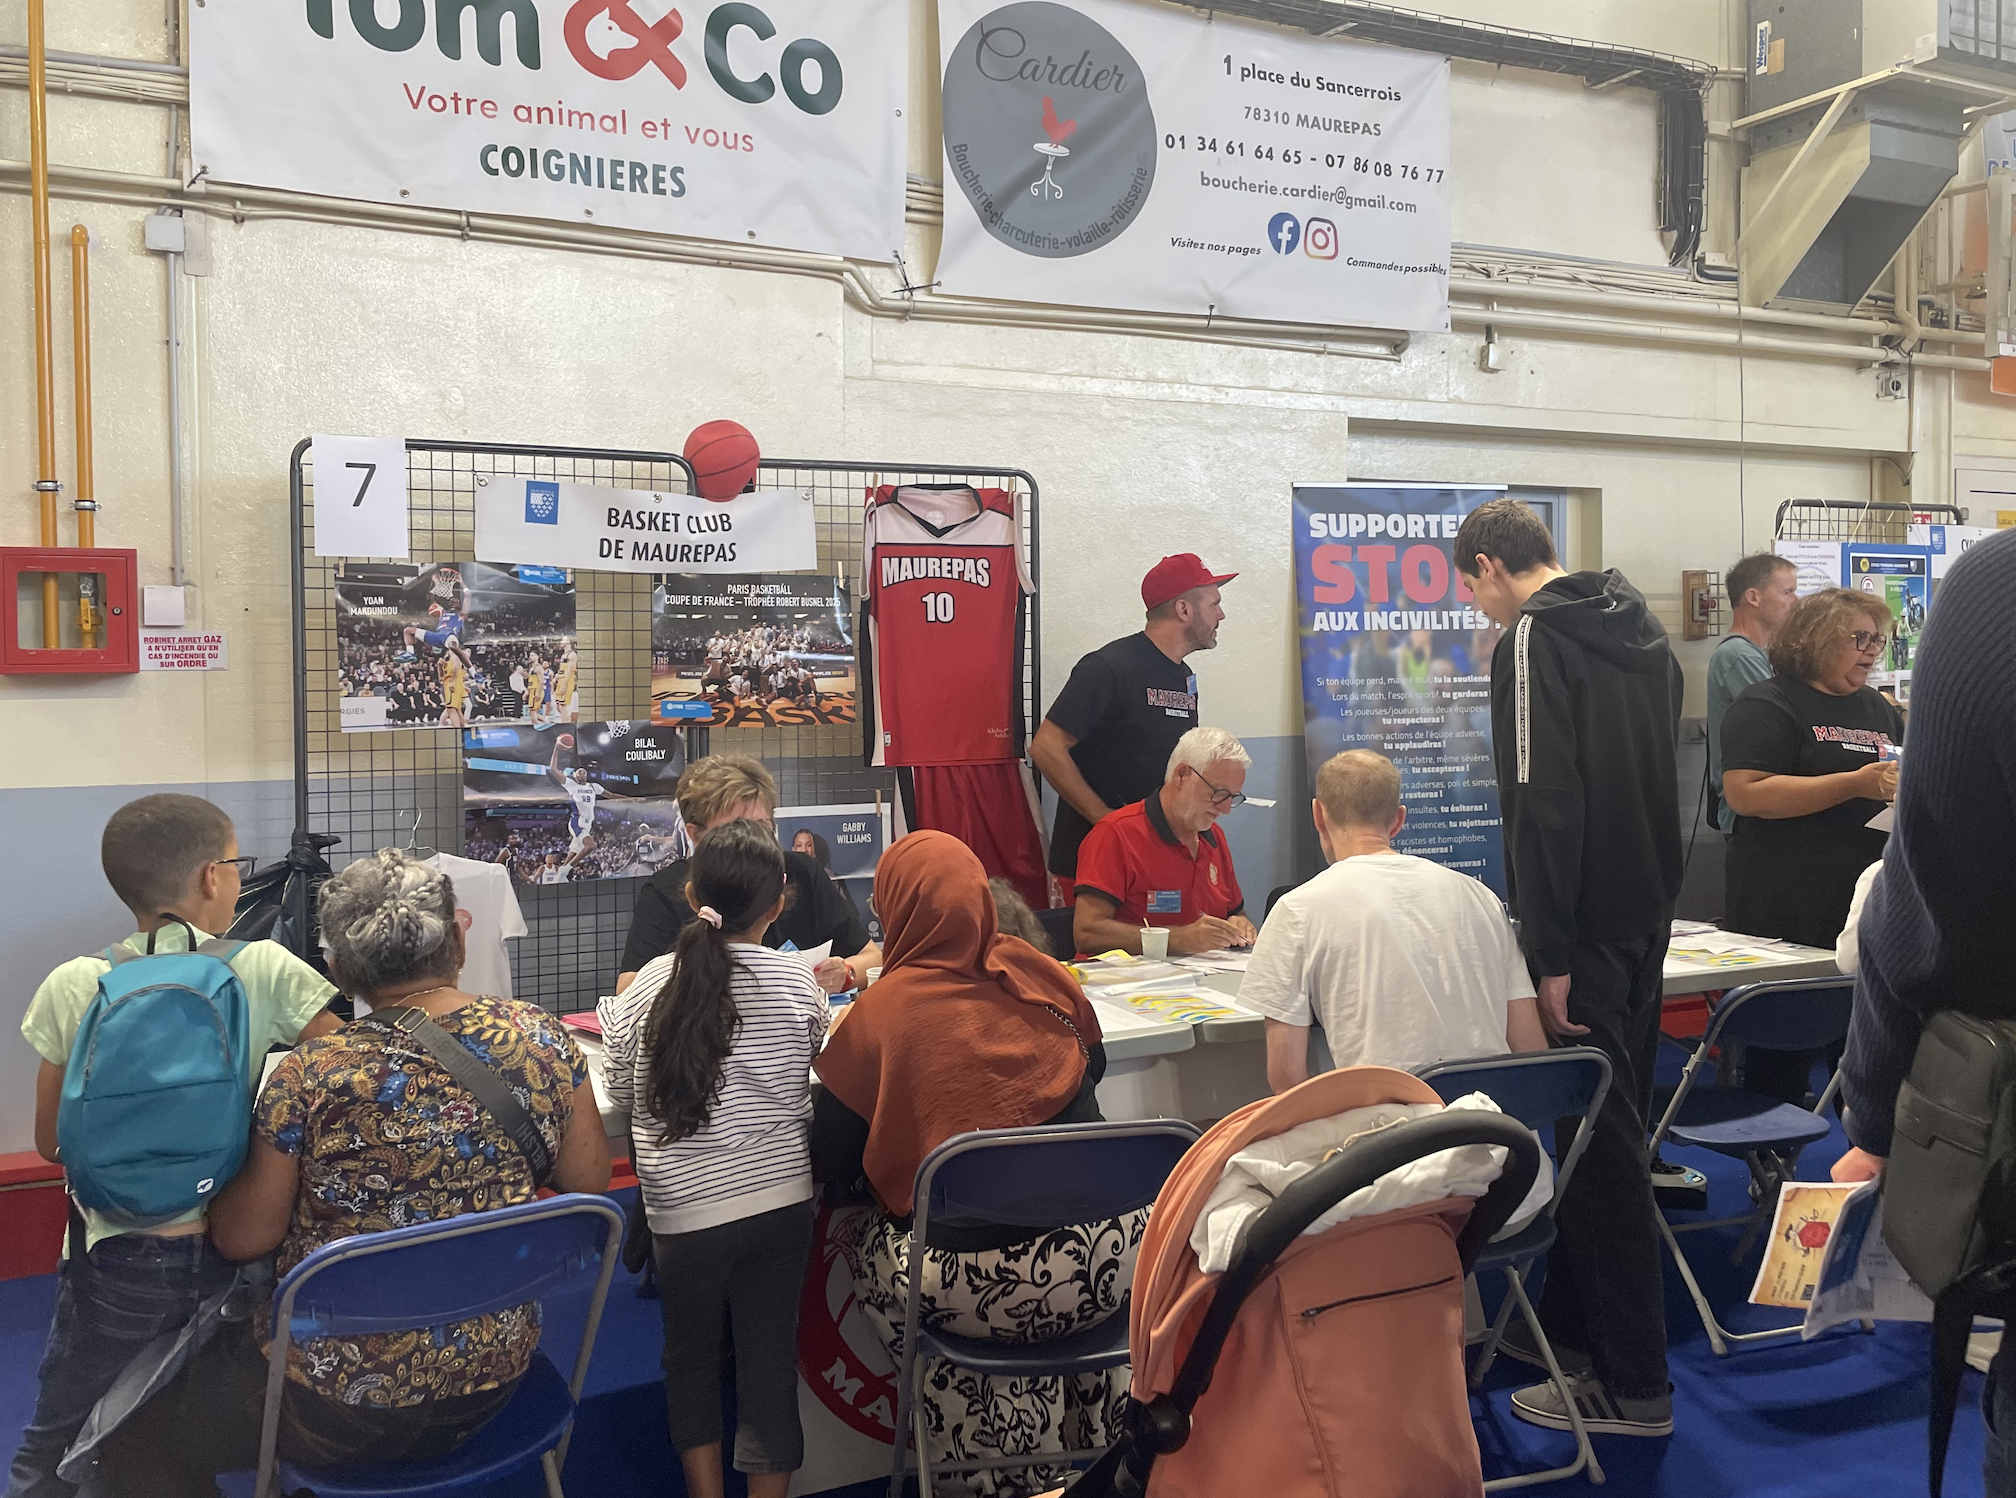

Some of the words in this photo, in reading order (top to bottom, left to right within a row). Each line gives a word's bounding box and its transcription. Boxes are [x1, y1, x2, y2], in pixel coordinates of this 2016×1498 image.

[1756, 27, 1766, 68] Wesper
[703, 2, 843, 116] Co
[975, 21, 1128, 94] Cardier
[1223, 55, 1233, 76] 1
[1241, 64, 1284, 87] place
[1290, 71, 1311, 90] du
[1316, 76, 1402, 102] Sancerrois
[403, 82, 499, 121] Votre
[513, 100, 628, 137] animal
[641, 118, 672, 141] et
[684, 126, 754, 153] vous
[1243, 106, 1290, 127] 78310
[1296, 114, 1382, 138] MAUREPAS
[1165, 134, 1186, 151] 01
[1197, 136, 1218, 153] 34
[1225, 138, 1246, 157] 61
[1254, 143, 1275, 161] 64
[1281, 147, 1303, 165] 65
[1325, 151, 1345, 170] 07
[1353, 156, 1369, 173] 86
[1373, 159, 1393, 178] 08
[1400, 163, 1420, 181] 76
[1425, 166, 1445, 184] 77
[479, 143, 687, 199] COIGNIERES
[1200, 171, 1418, 214] boucherie.cardier@gmail.com
[1170, 236, 1204, 254] Visitez
[1206, 241, 1225, 254] nos
[1227, 244, 1261, 258] pages
[345, 461, 377, 507] 7
[607, 506, 681, 532] BASKET
[686, 512, 733, 534] CLUB
[1309, 513, 1469, 539] SUPPORTE
[599, 538, 624, 560] DE
[630, 540, 737, 563] MAUREPAS
[881, 556, 991, 588] MAUREPAS
[727, 585, 749, 594] PARIS
[750, 584, 792, 595] BASKETBALL
[363, 596, 384, 605] YOAN
[665, 595, 690, 605] COUPE
[692, 596, 703, 605] DE
[704, 596, 734, 606] FRANCE
[744, 595, 775, 607] TROPHÉE
[776, 597, 800, 607] ROBERT
[801, 597, 825, 607] BUSNEL
[350, 606, 398, 615] MAKOUNDOU
[921, 592, 954, 623] 10
[1313, 611, 1359, 631] AUX
[1364, 605, 1490, 630] INCIVILITÉS
[204, 635, 222, 643] GAZ
[165, 652, 206, 660] D'INCENDIE
[177, 659, 207, 667] ORDRE
[1316, 677, 1324, 686] Si
[1341, 677, 1365, 687] équipe
[1366, 676, 1386, 687] perd,
[1387, 676, 1413, 686] malgré
[1444, 675, 1451, 683] la
[1332, 693, 1348, 701] Lors
[1350, 692, 1358, 700] du
[1361, 692, 1386, 701] match,
[1388, 691, 1413, 701] l'esprit
[1452, 690, 1488, 700] garderas
[1341, 708, 1353, 716] Les
[1354, 706, 1419, 717] joueuses/joueurs
[1421, 706, 1434, 714] des
[1454, 705, 1486, 715] équipes,
[1393, 716, 1440, 726] respecteras
[1343, 733, 1355, 741] Les
[1357, 732, 1384, 740] bonnes
[1386, 732, 1413, 740] actions
[1415, 731, 1424, 739] de
[1426, 730, 1454, 740] l'équipe
[1455, 729, 1487, 738] adverse,
[634, 737, 656, 748] BILAL
[1394, 741, 1442, 751] applaudiras
[625, 749, 666, 762] COULIBALY
[1393, 756, 1403, 764] de
[1404, 755, 1436, 764] l'arbitre,
[1437, 754, 1459, 763] même
[1461, 753, 1490, 762] sévères
[1422, 765, 1465, 774] accepteras
[1411, 780, 1446, 789] adverses,
[1447, 780, 1461, 789] poli
[1472, 778, 1499, 788] simple,
[1405, 791, 1439, 799] resteras
[1408, 806, 1439, 814] insultes,
[1450, 804, 1483, 813] éviteras
[842, 822, 866, 832] GABBY
[1402, 822, 1410, 830] et
[1411, 821, 1448, 830] violences,
[1449, 820, 1458, 828] tu
[1459, 819, 1498, 829] rejetteras
[836, 833, 872, 844] WILLIAMS
[1397, 836, 1427, 846] racistes
[1428, 836, 1436, 844] et
[1437, 834, 1488, 845] homophobes,
[1402, 846, 1449, 855] dénonceras
